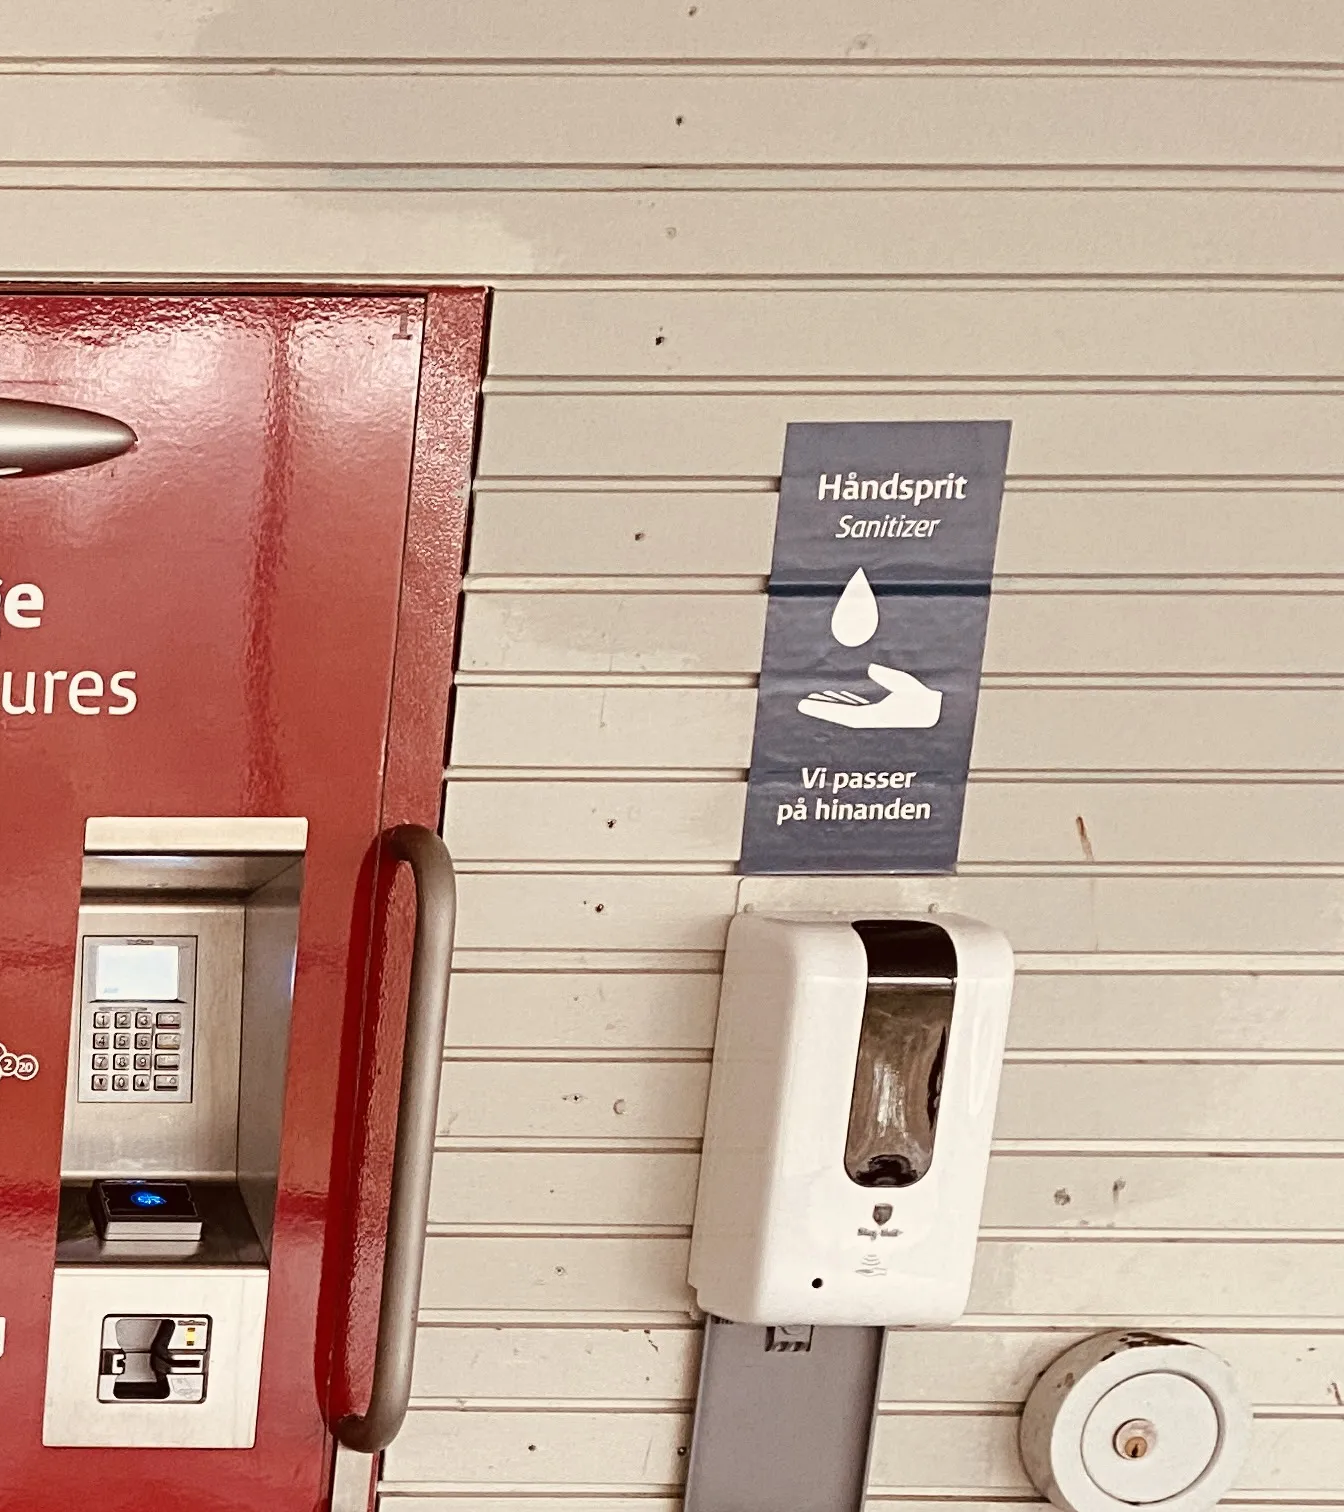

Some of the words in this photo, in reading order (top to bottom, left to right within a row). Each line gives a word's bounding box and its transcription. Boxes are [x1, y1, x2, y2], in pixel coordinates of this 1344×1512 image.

[818, 472, 968, 506] Håndsprit
[835, 514, 941, 539] Sanitizer
[801, 767, 827, 790] Vi
[833, 770, 917, 793] passer
[776, 797, 808, 826] på
[815, 798, 931, 821] hinanden
[3, 1059, 12, 1071] 2
[19, 1062, 33, 1073] 20
